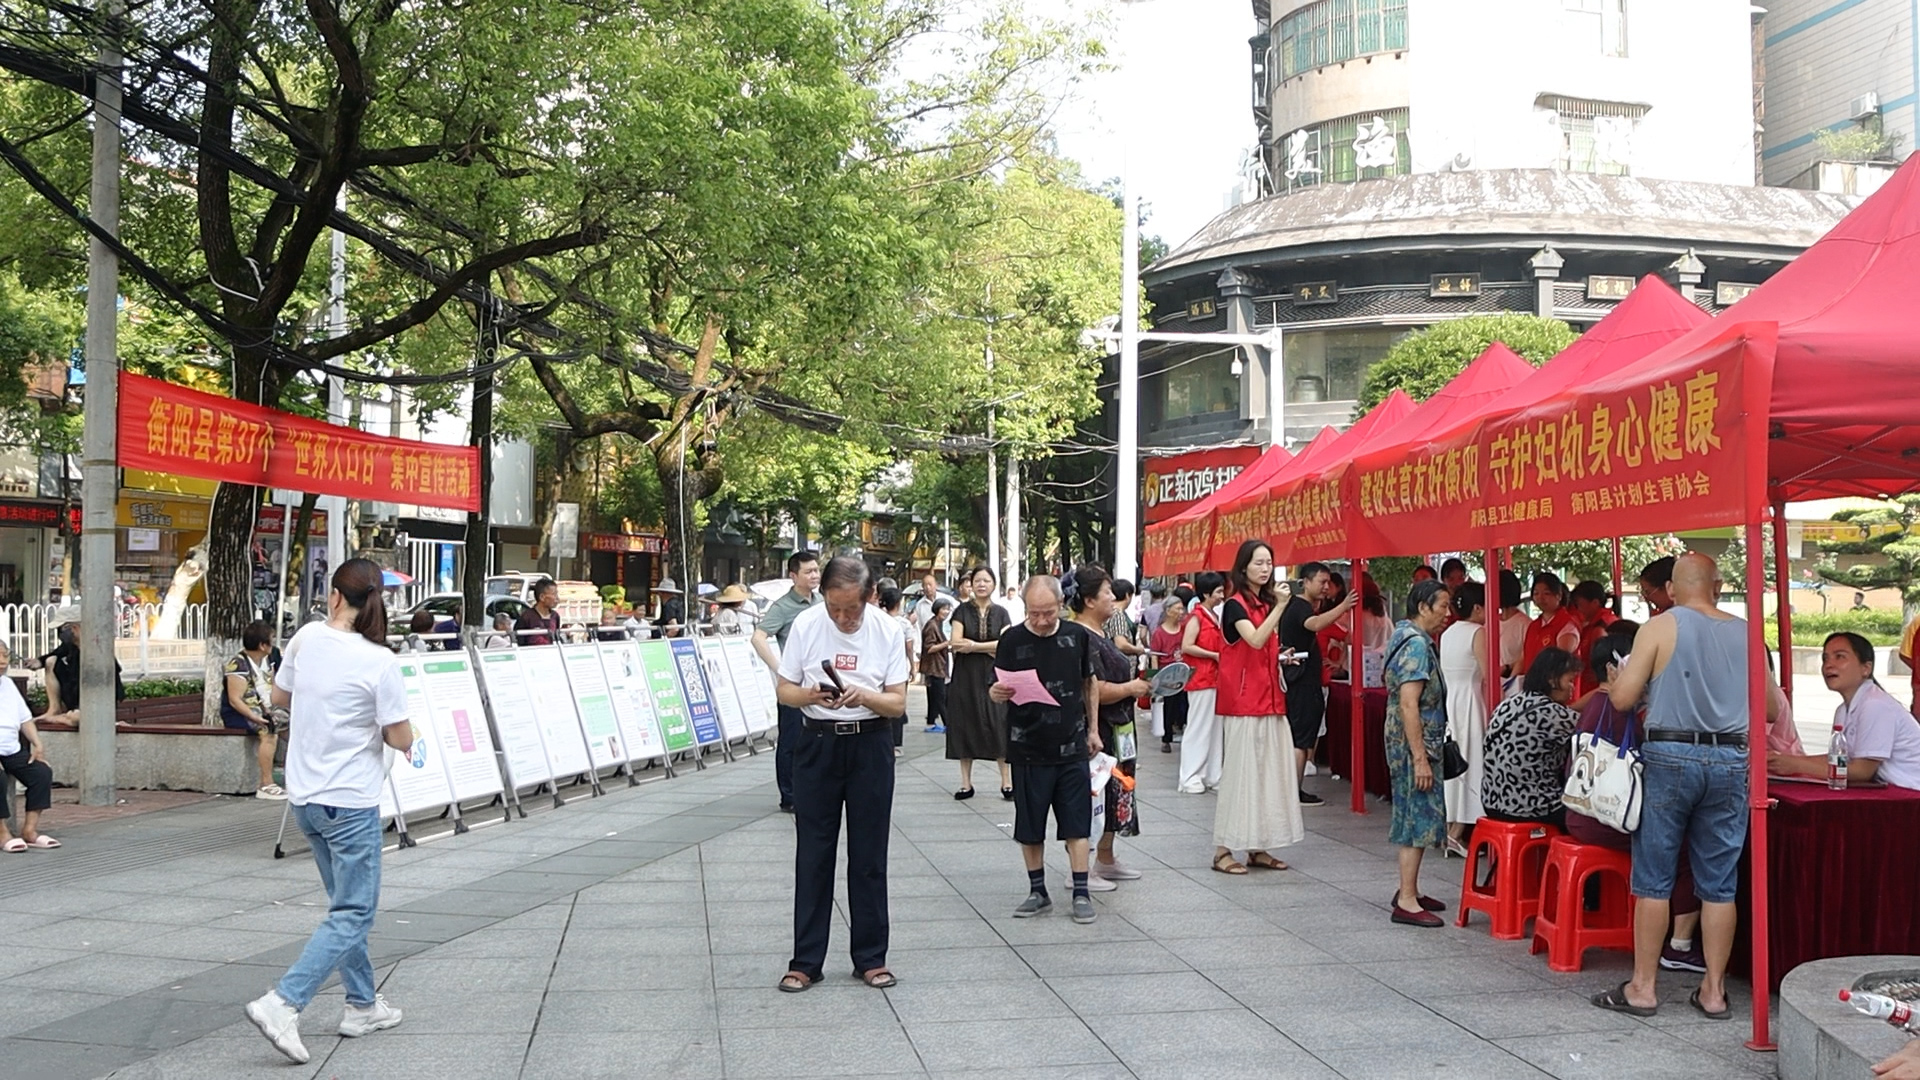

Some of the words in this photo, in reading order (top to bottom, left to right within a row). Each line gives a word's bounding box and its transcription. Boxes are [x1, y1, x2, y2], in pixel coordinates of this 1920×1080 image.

[1360, 445, 1480, 518] 建设生育友好衡阳
[1489, 369, 1722, 494] 守护妇幼身心健康
[1571, 470, 1710, 516] 衡阳县计划生育协会
